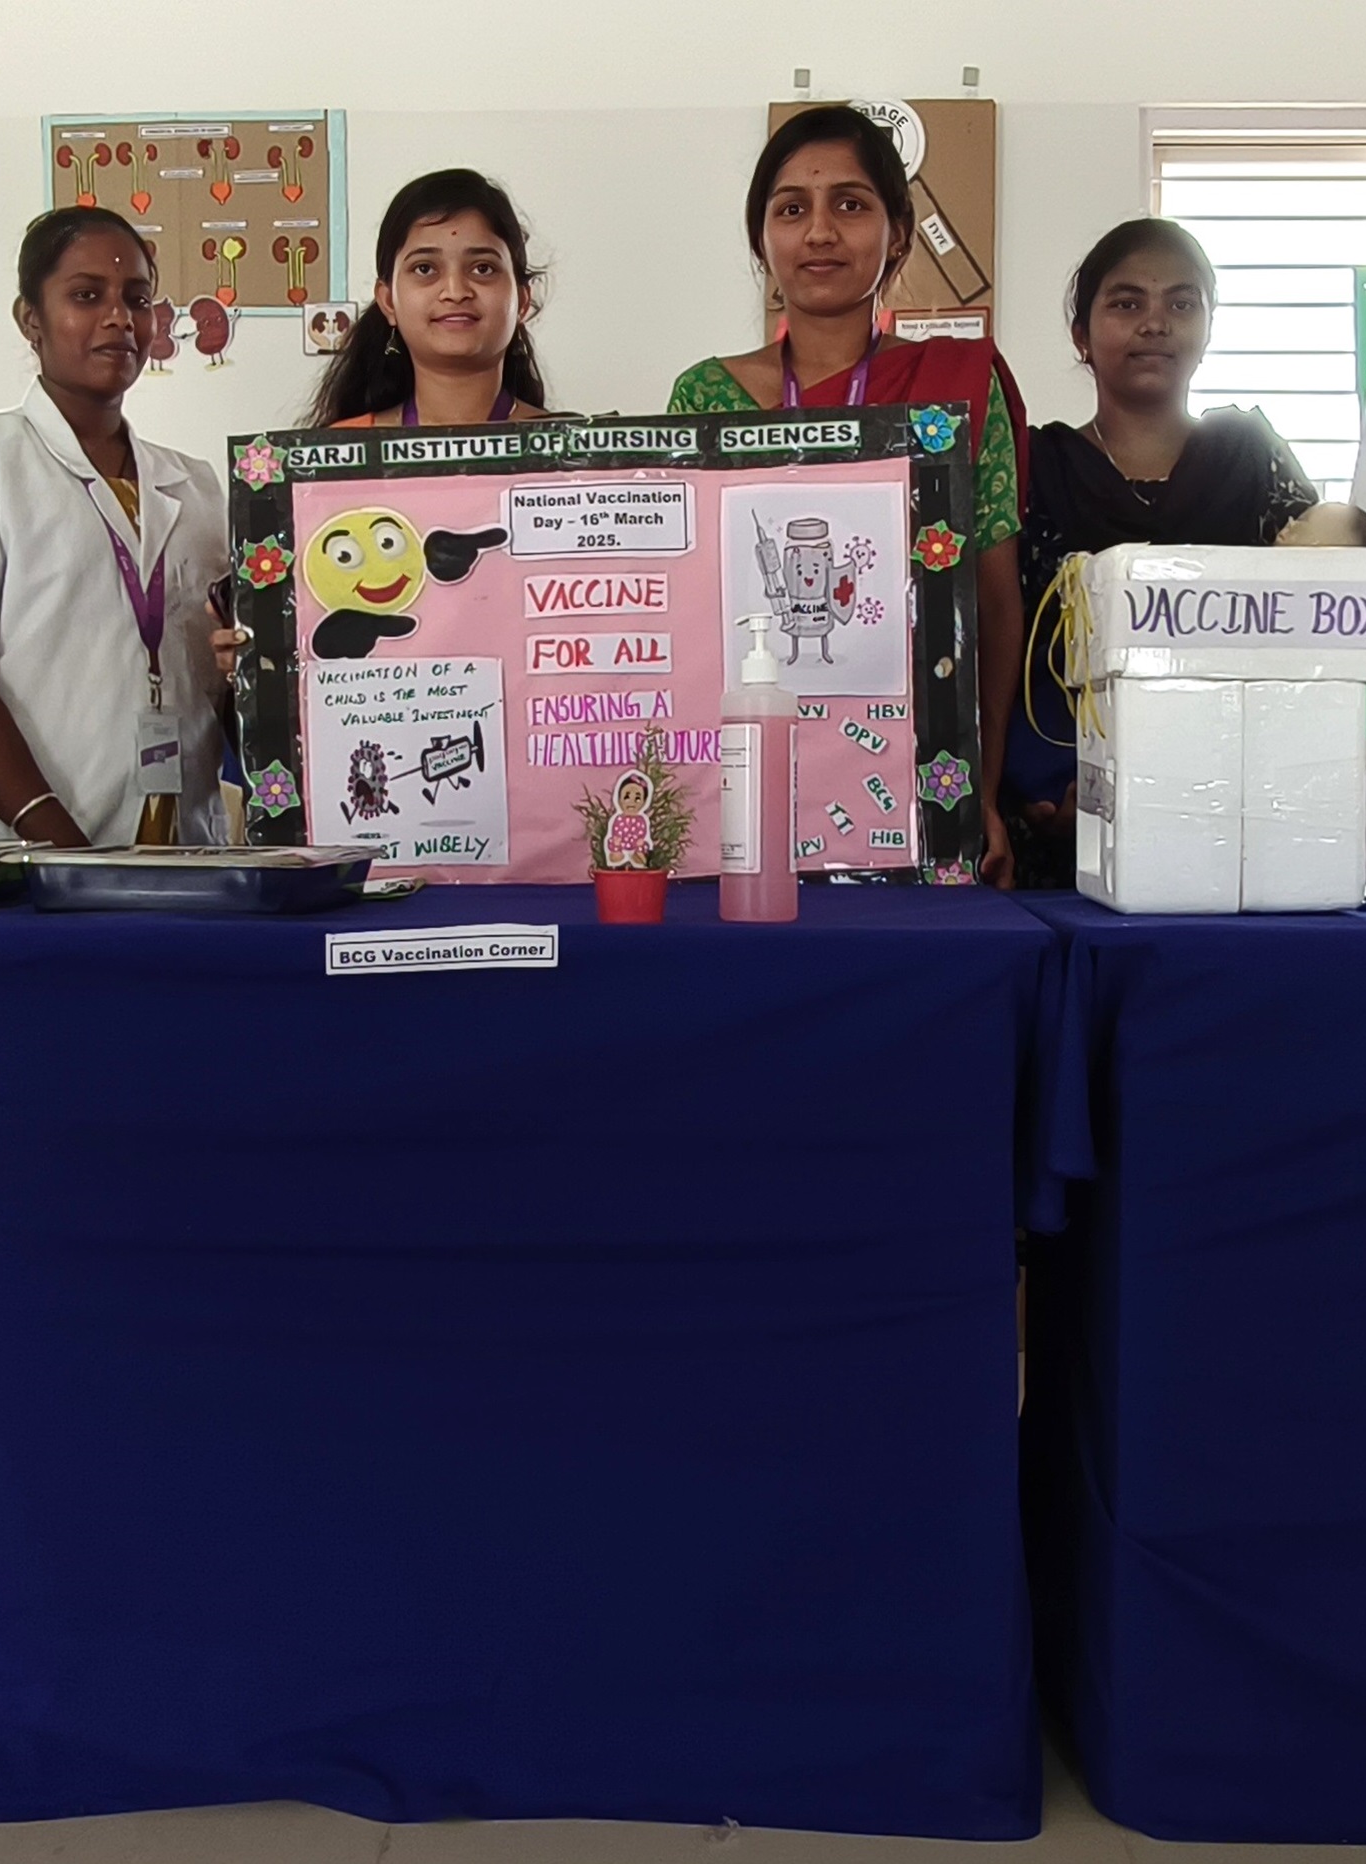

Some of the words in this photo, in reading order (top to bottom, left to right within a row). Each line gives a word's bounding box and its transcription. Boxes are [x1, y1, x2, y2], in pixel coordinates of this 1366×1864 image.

[854, 103, 909, 127] RIAGE
[290, 445, 364, 466] SARJI
[384, 437, 520, 461] INSTITUTE
[529, 433, 561, 451] OF
[573, 430, 692, 450] NURSING
[723, 424, 861, 448] SCIENCES,
[514, 493, 581, 507] National
[586, 491, 682, 504] Vaccination
[533, 516, 563, 531] Day
[580, 512, 610, 526] 16th
[614, 513, 664, 525] March
[577, 534, 621, 548] 2025.
[527, 578, 665, 612] VACCINE
[1124, 585, 1294, 638] VACCINE
[533, 638, 594, 669] FOR
[614, 638, 668, 665] ALL
[317, 663, 418, 685] VACCINATION
[432, 663, 452, 677] OF
[464, 662, 477, 674] A
[324, 693, 367, 707] CHILD
[374, 691, 386, 703] IS
[427, 685, 468, 697] MOST
[341, 712, 404, 726] VALUABLE
[532, 691, 641, 727] ENSURING
[652, 689, 669, 718] A
[867, 704, 906, 719] HBV
[844, 722, 884, 750] OPV
[867, 777, 894, 811] BCG
[829, 804, 854, 829] TT
[871, 831, 904, 845] HIB
[339, 950, 377, 964] BCG
[382, 945, 484, 962] Vaccination
[489, 944, 546, 957] Corner
